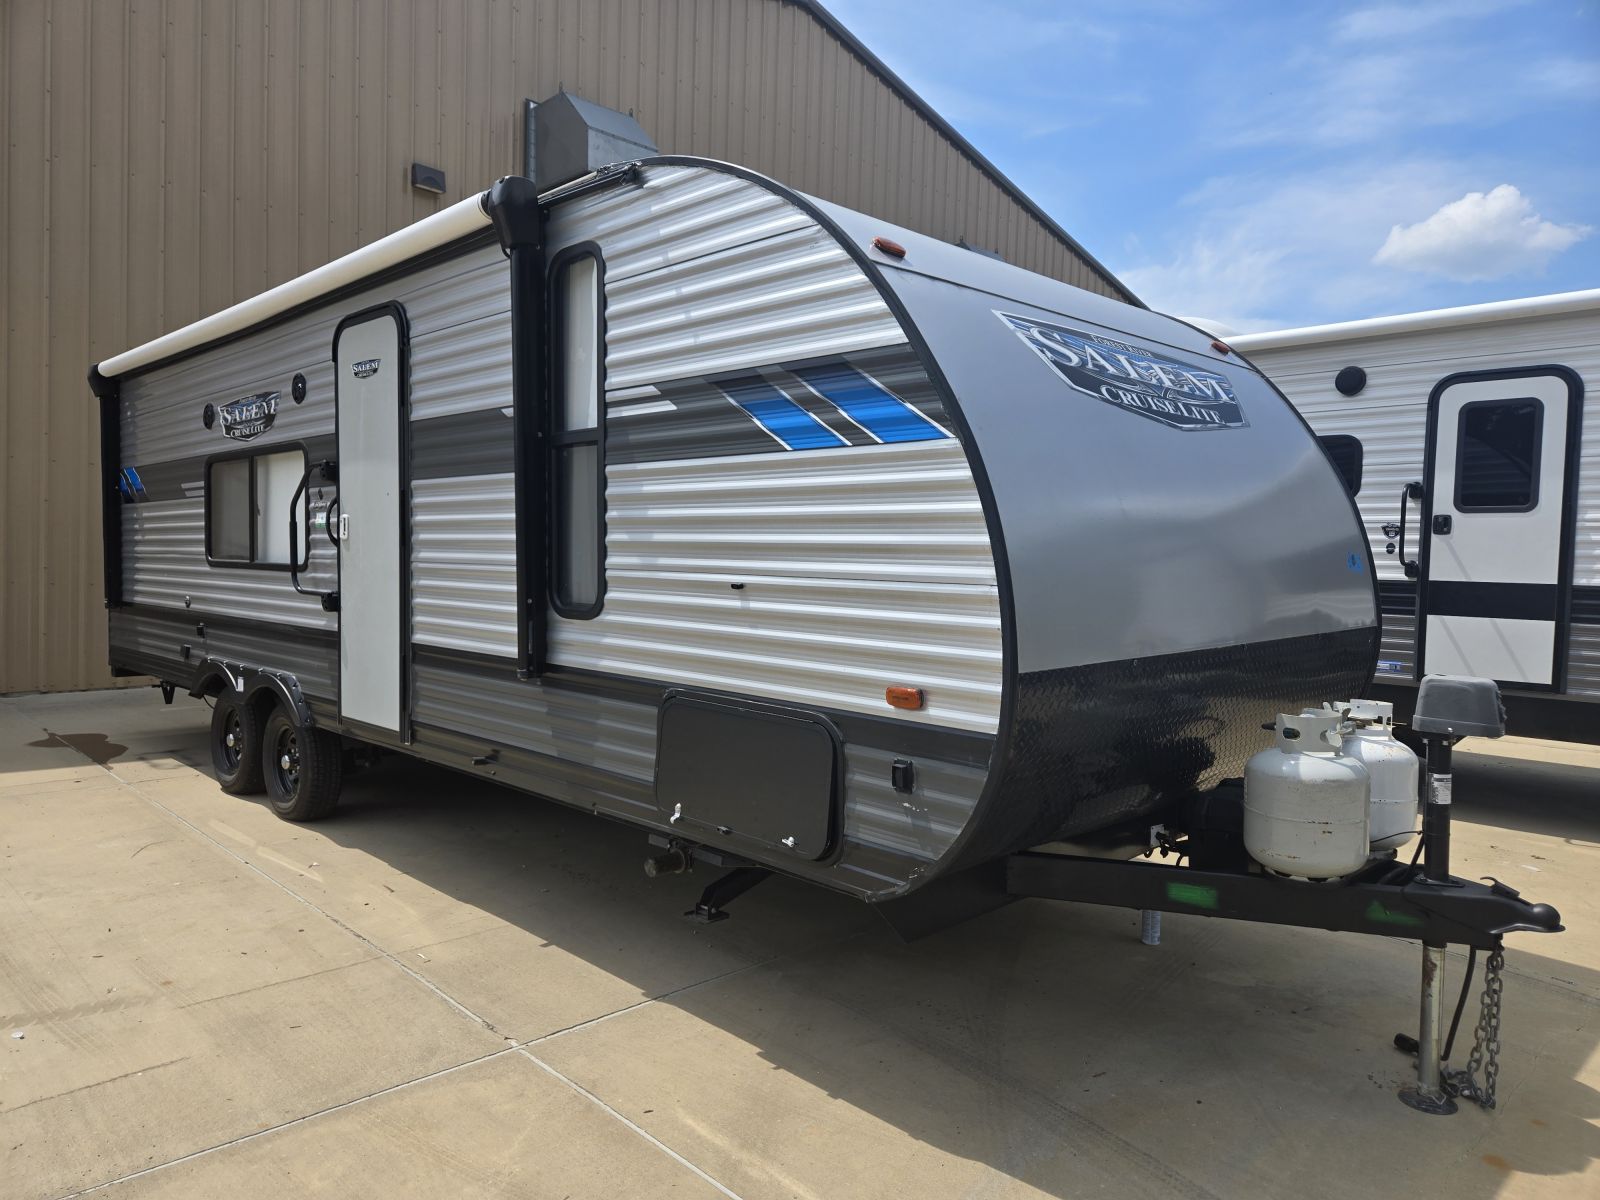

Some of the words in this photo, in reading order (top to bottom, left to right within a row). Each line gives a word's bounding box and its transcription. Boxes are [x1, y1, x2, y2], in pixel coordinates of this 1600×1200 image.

[353, 361, 378, 373] SALEM
[1029, 326, 1234, 402] SALEM
[222, 398, 280, 426] SALEM
